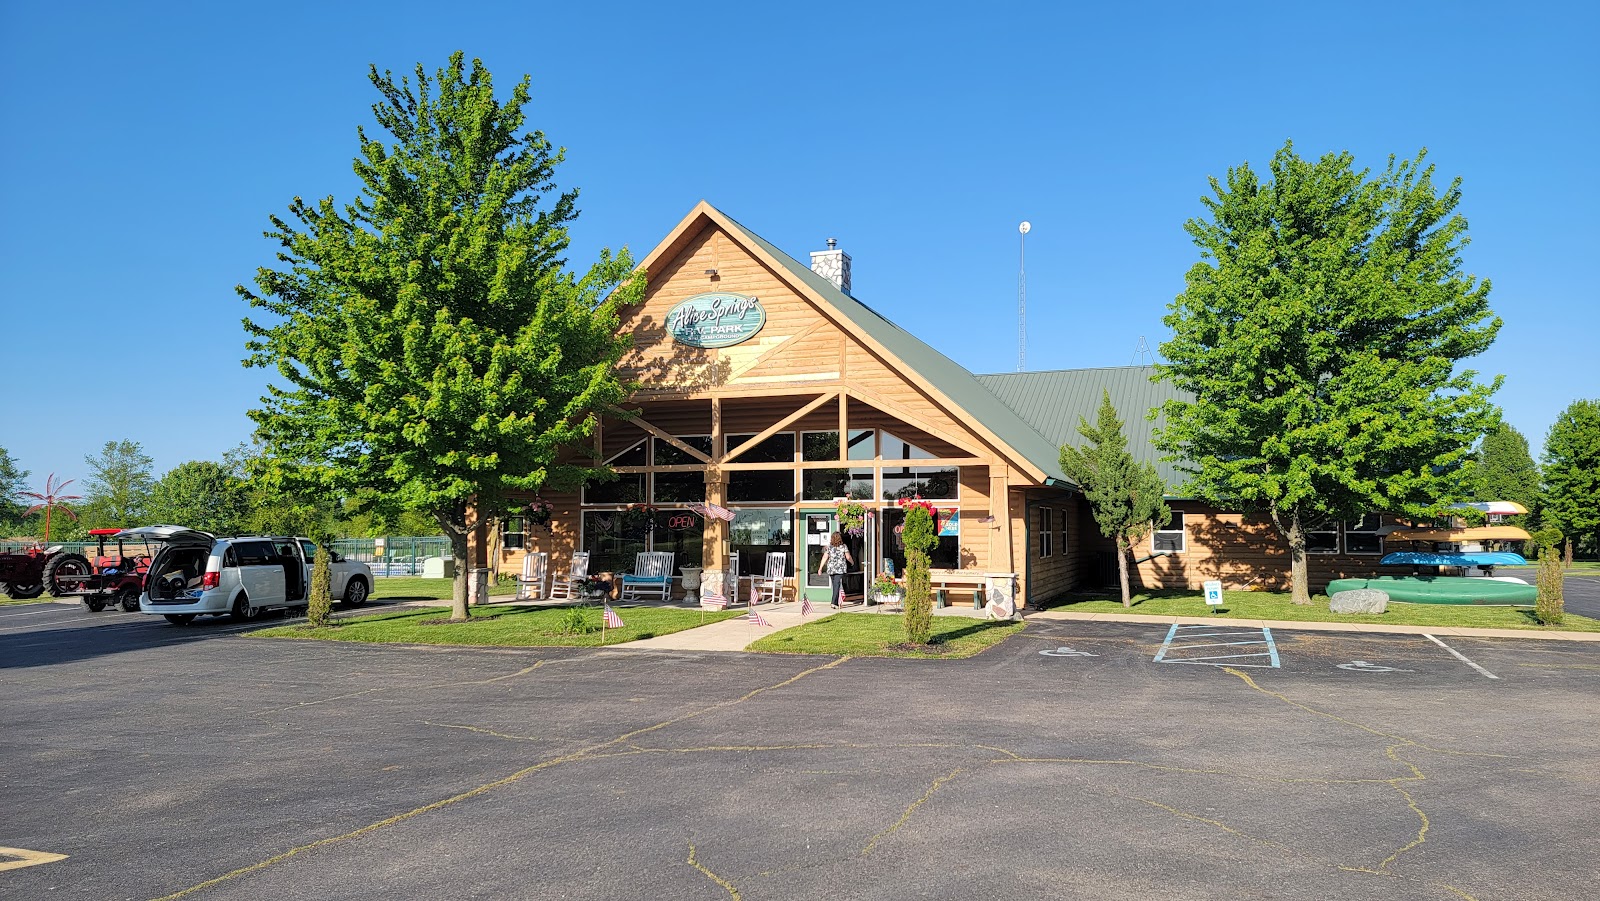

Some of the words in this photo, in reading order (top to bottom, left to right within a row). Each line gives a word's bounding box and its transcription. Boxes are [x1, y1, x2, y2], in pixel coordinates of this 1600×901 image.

[672, 306, 707, 330] Alice
[708, 296, 757, 326] Springs
[711, 324, 743, 334] PARK
[668, 516, 695, 528] OPEN
